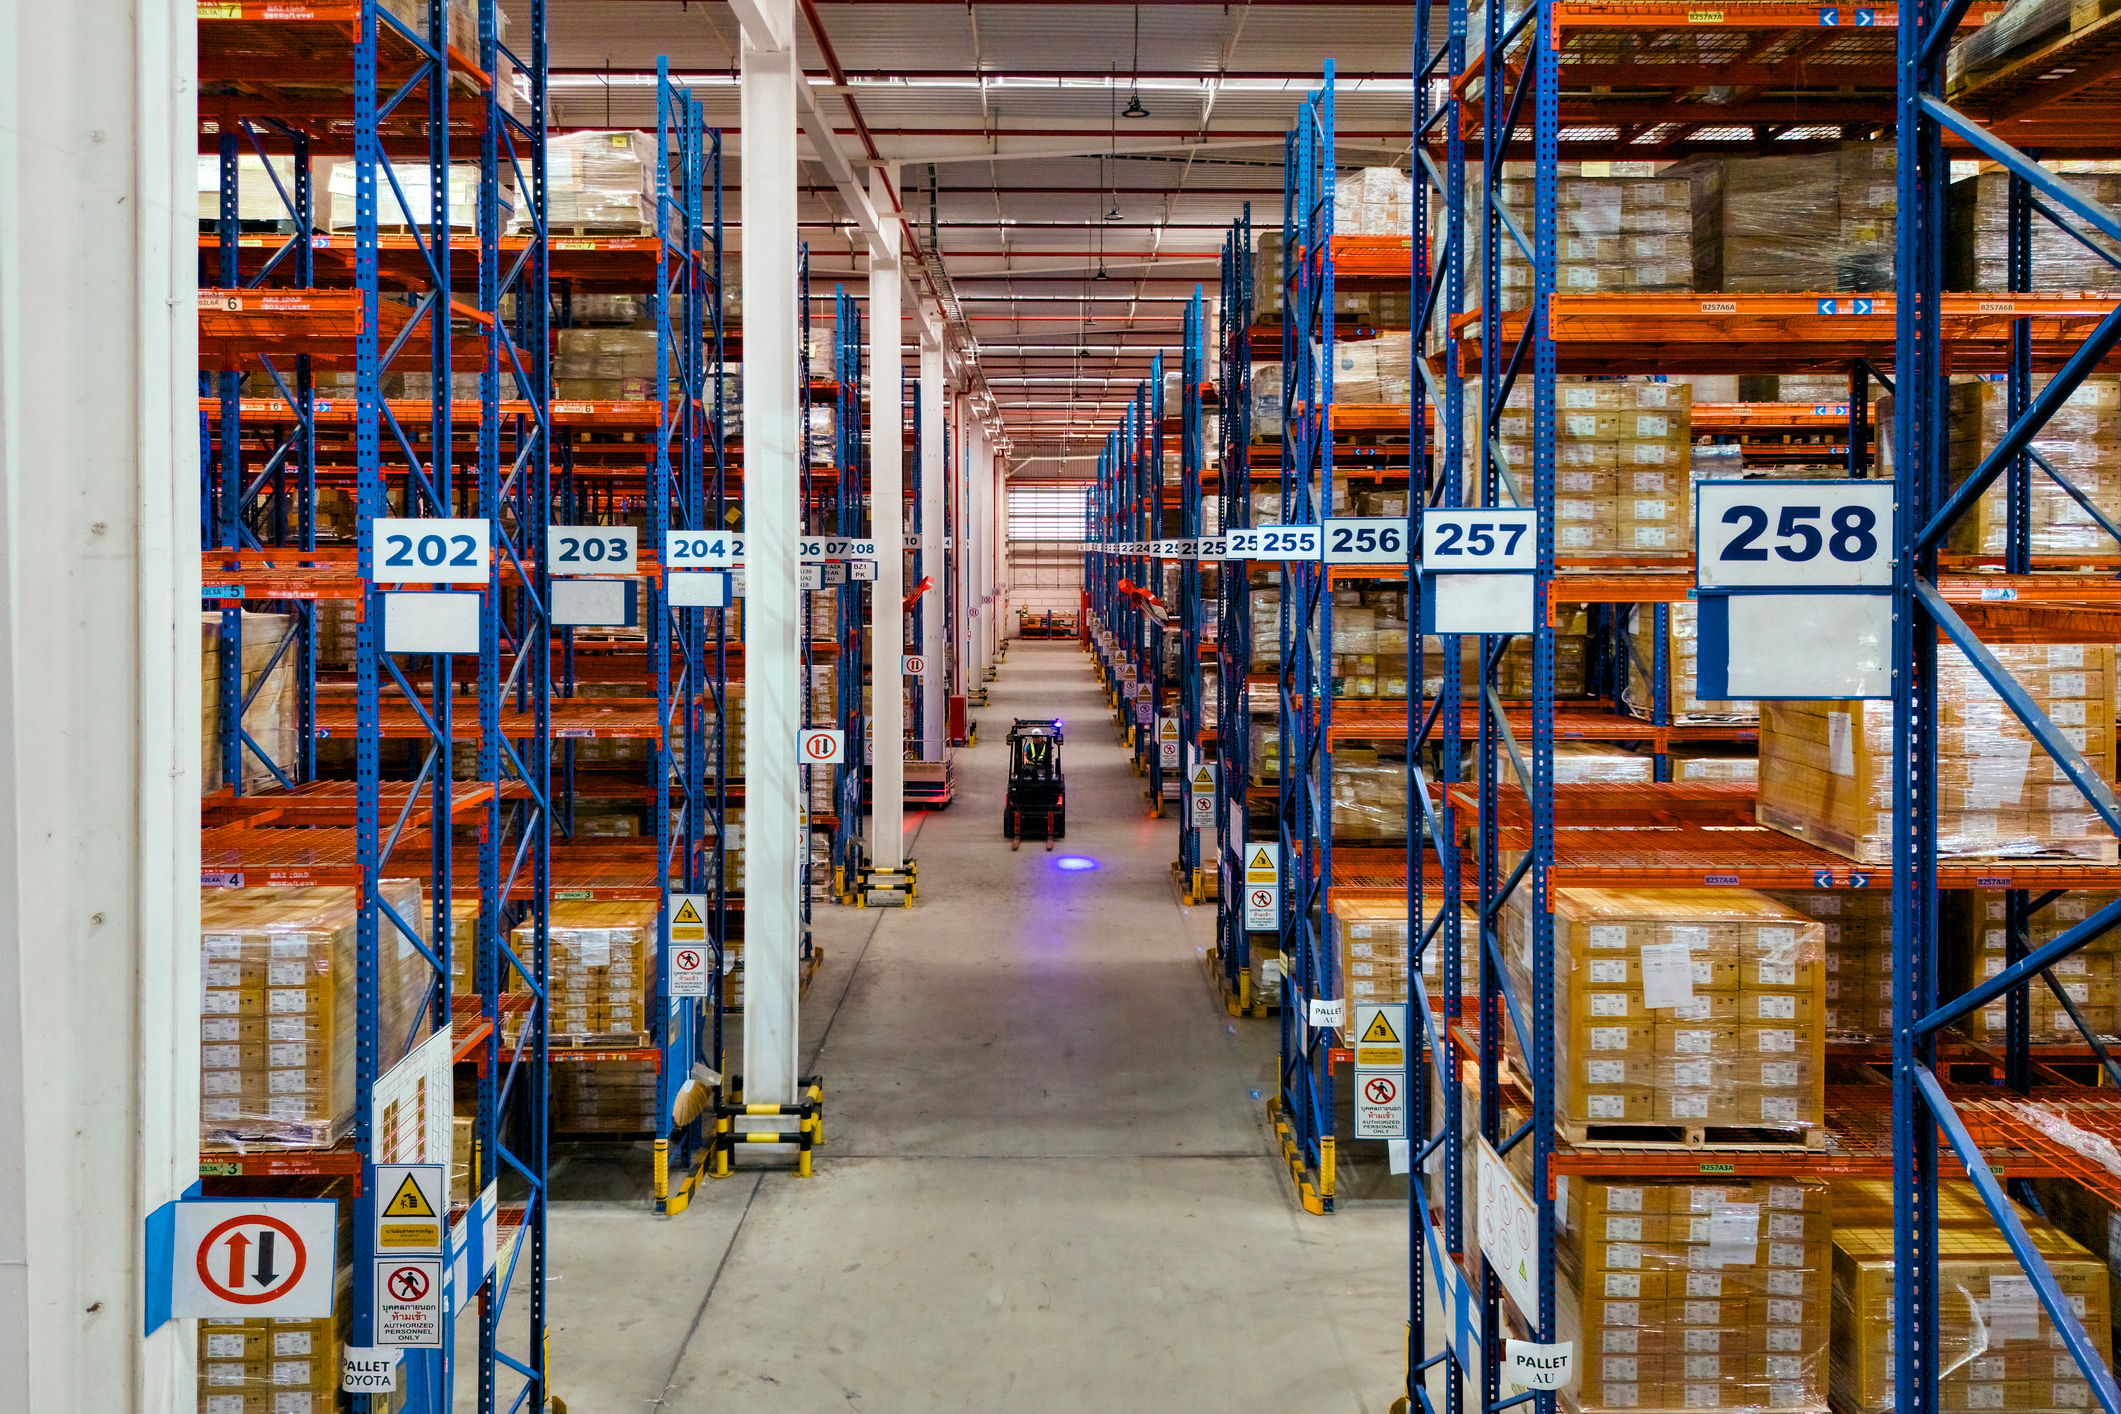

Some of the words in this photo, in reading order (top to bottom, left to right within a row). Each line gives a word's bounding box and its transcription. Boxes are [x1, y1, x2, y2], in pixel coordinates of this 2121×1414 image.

[227, 5, 236, 17] 7
[227, 297, 238, 310] 6
[1702, 303, 1736, 311] B257A6A
[1980, 303, 2013, 311] B257A6B
[585, 404, 591, 413] 6
[1434, 523, 1528, 556] 257
[1719, 505, 1878, 562] 258
[904, 537, 918, 545] 10
[1232, 535, 1258, 551] 25
[1263, 533, 1315, 552] 255
[1331, 528, 1401, 553] 256
[385, 534, 478, 566] 202
[558, 537, 629, 562] 203
[673, 539, 726, 558] 204
[800, 542, 821, 556] 06
[826, 542, 848, 554] 07
[1136, 543, 1150, 553] 24
[1202, 541, 1227, 555] 25
[230, 585, 240, 598] 5
[229, 873, 239, 887] 4
[1705, 876, 1738, 885] B257A4A
[1977, 878, 2010, 886] B257A4B
[1315, 1007, 1342, 1015] PALLET
[227, 1162, 238, 1175] 3
[1701, 1164, 1734, 1172] B257A3A
[392, 1311, 427, 1321] ห้ามเข้า
[1516, 1354, 1568, 1369] PALLET
[344, 1373, 391, 1386] OYOTA
[1533, 1372, 1555, 1384] AU
